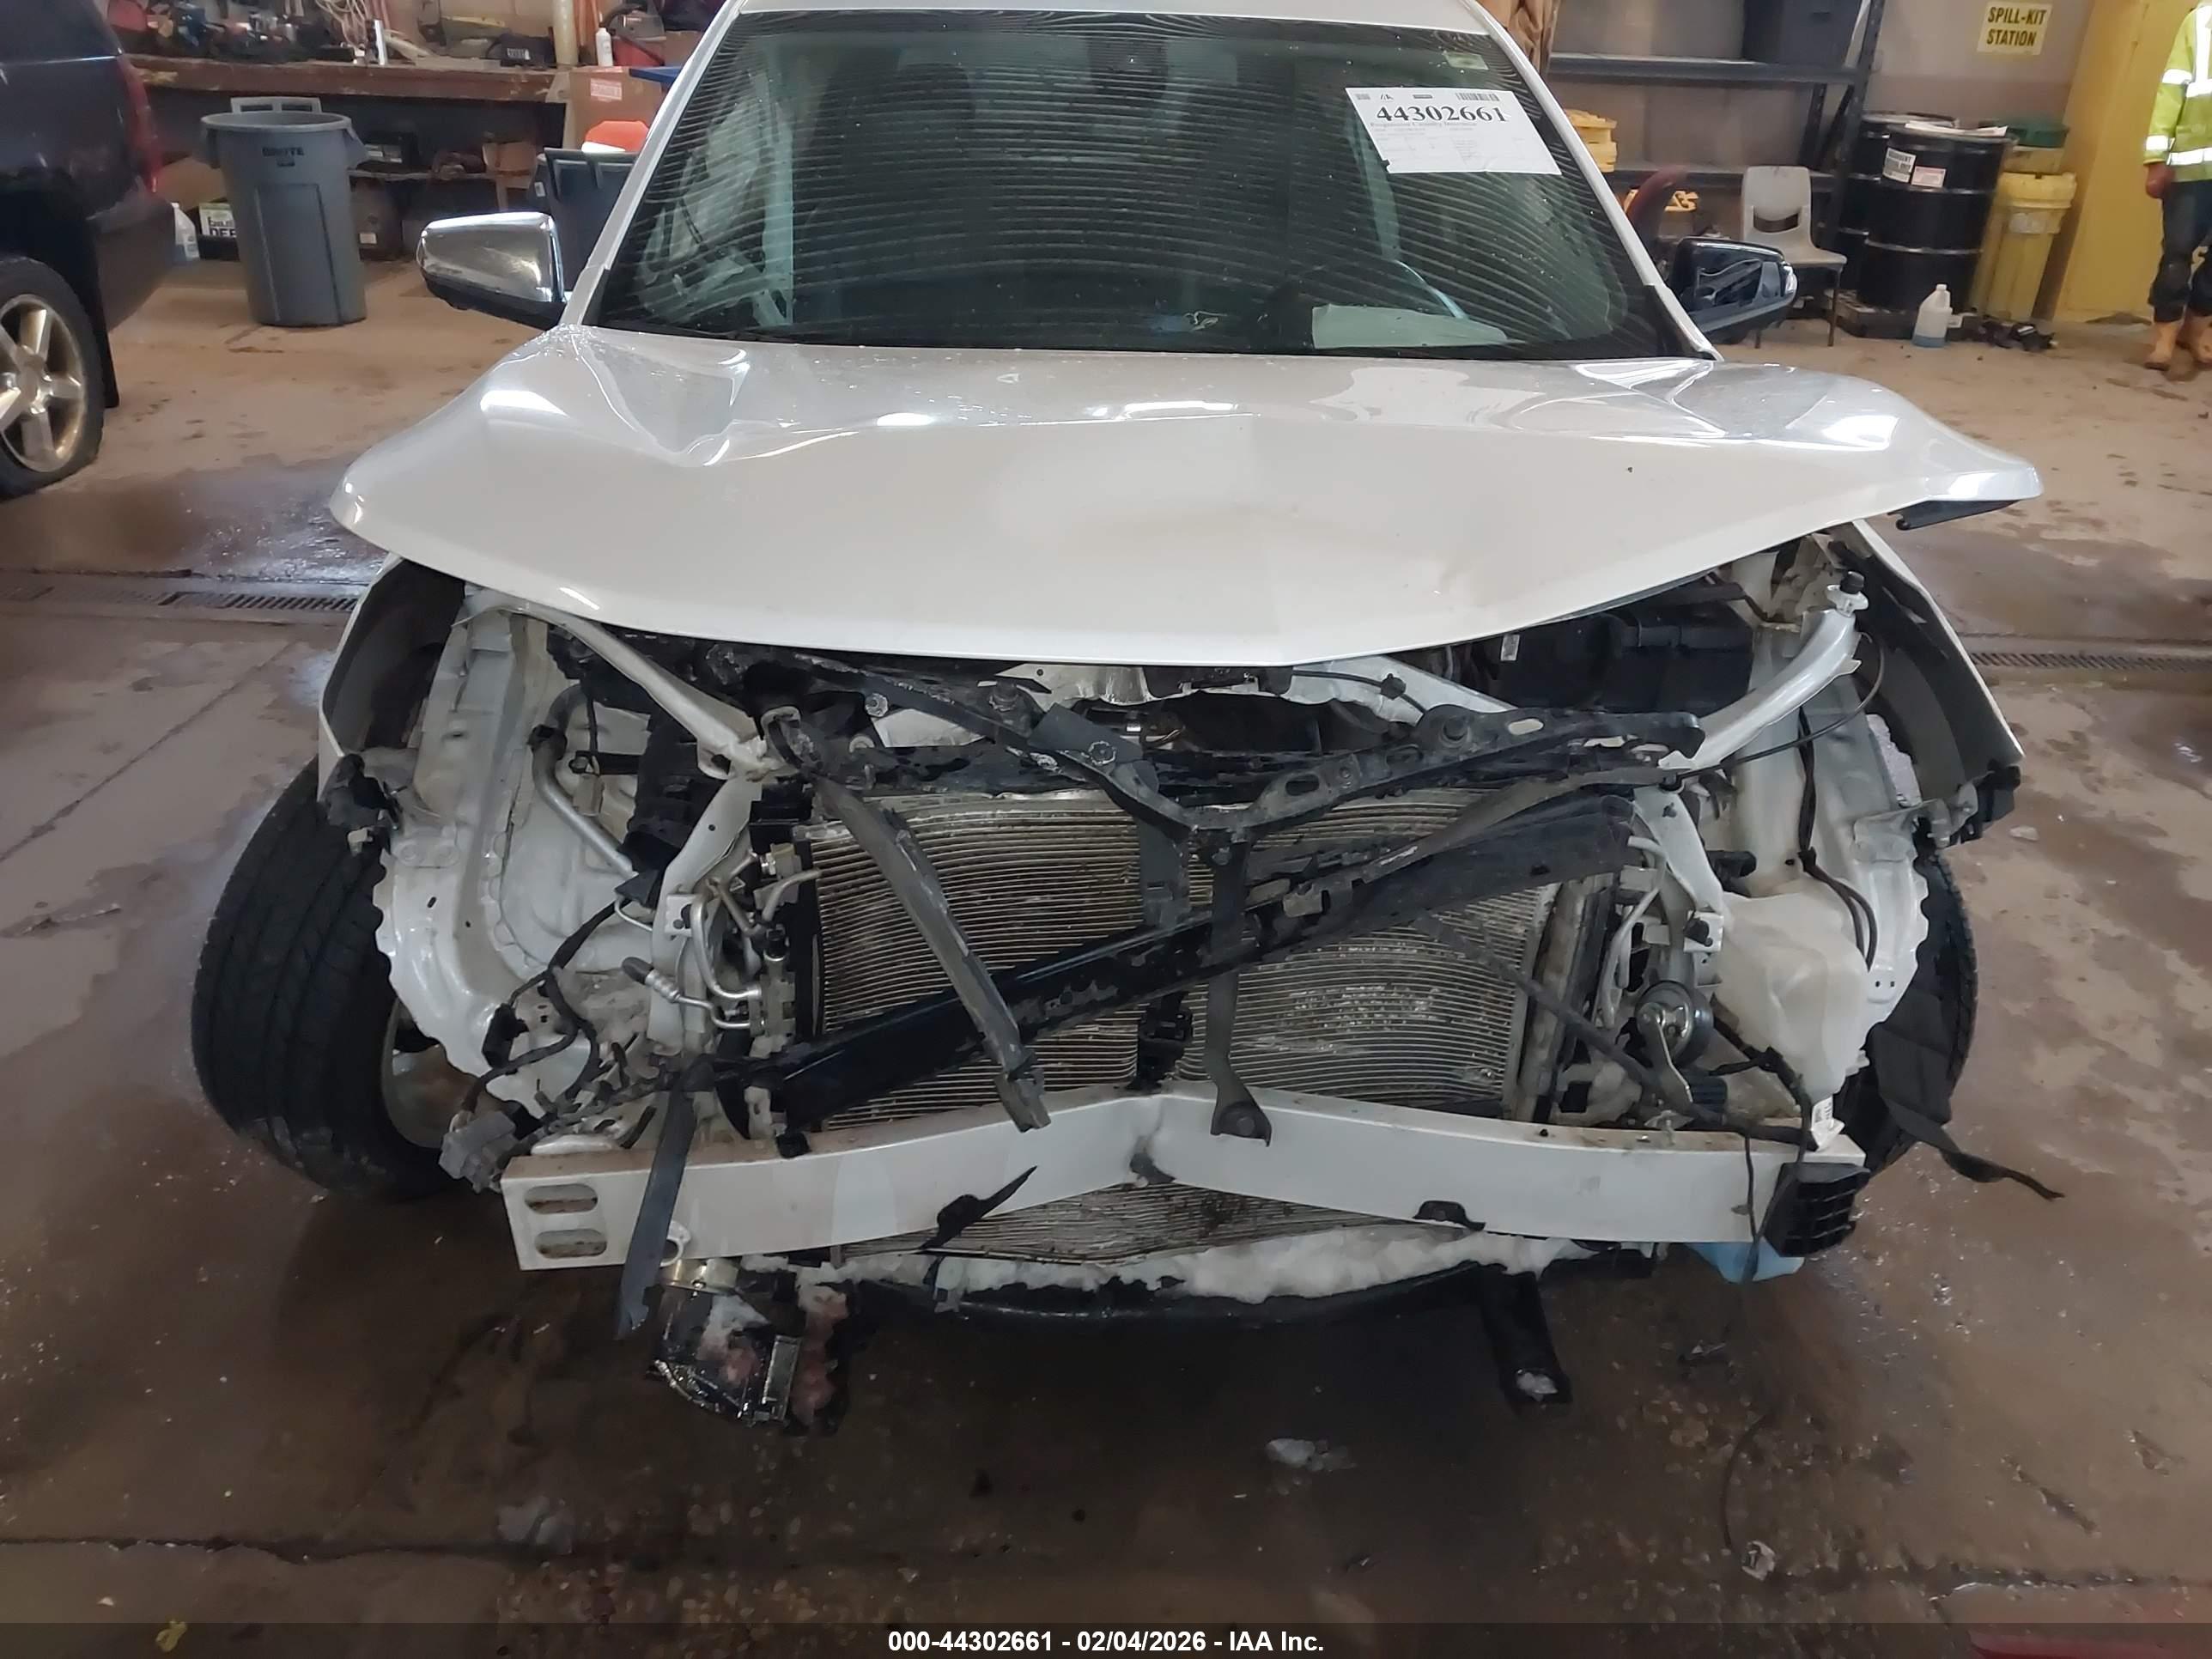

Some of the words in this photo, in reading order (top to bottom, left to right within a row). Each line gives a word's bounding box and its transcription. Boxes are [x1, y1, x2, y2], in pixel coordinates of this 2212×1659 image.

[1988, 7, 2047, 25] SPILL-KIT
[1987, 28, 2037, 46] STATION
[1376, 106, 1506, 122] 44302661
